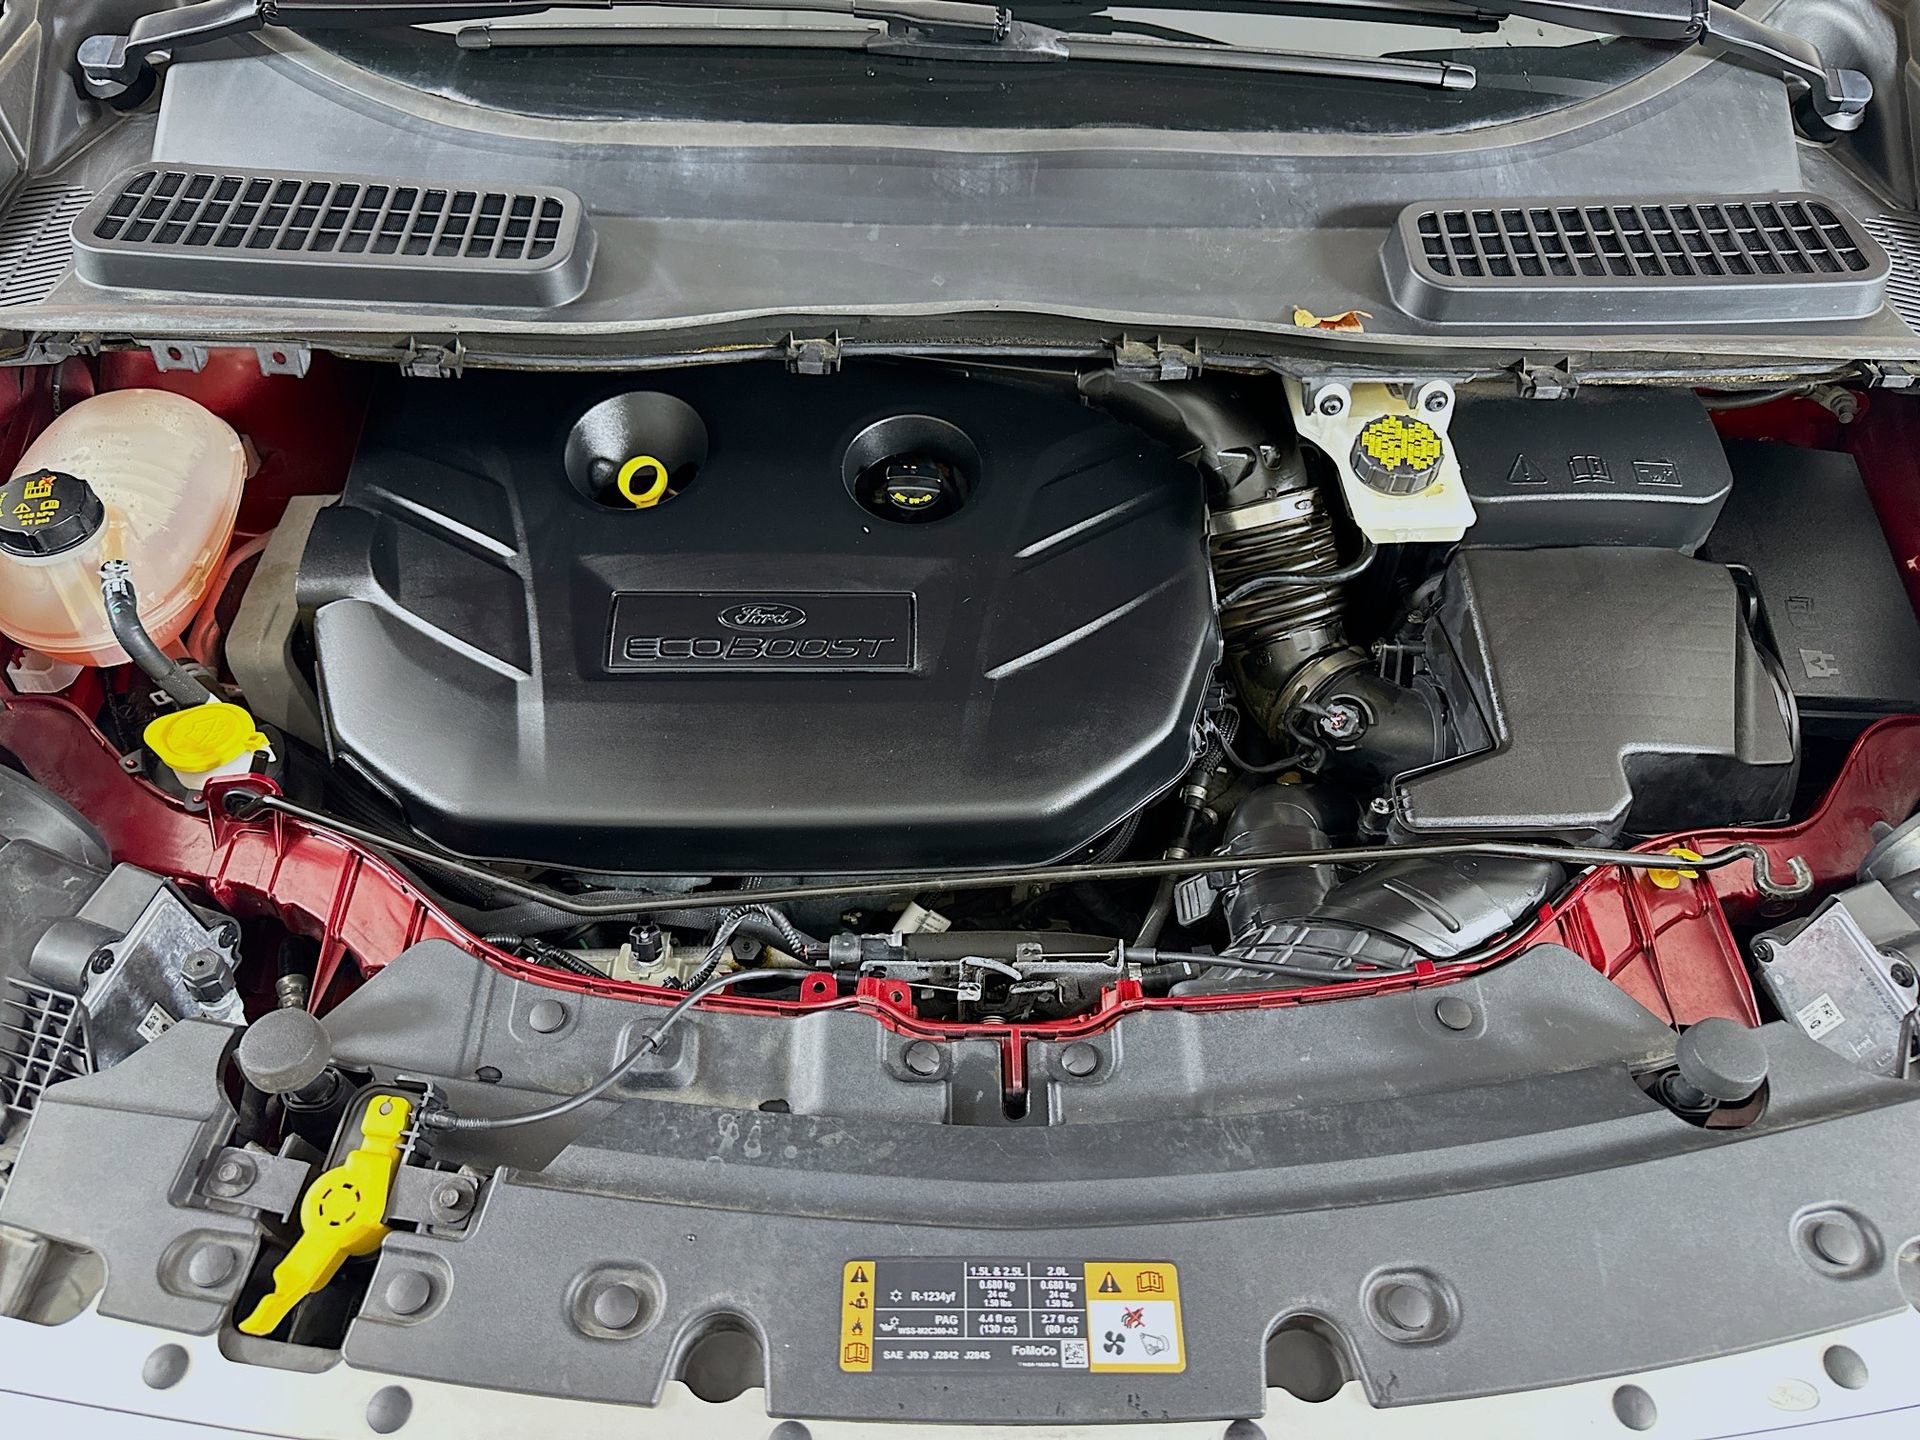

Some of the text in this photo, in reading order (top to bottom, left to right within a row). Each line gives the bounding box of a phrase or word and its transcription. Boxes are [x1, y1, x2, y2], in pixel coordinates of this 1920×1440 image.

[734, 605, 791, 624] Ford
[970, 1266, 1024, 1276] 1.5L & 2.5L
[1047, 1266, 1069, 1276] 2.0L
[1004, 1280, 1016, 1292] kg
[1065, 1280, 1077, 1292] kg
[911, 1291, 956, 1303] R-1234yf
[1000, 1299, 1012, 1307] lbs
[1062, 1300, 1074, 1308] lbs
[935, 1314, 959, 1325] PAG
[978, 1314, 1017, 1324] 4.4 fl oz
[1041, 1314, 1079, 1324] 2.7 fl oz
[1002, 1325, 1018, 1336] cc)
[1062, 1325, 1078, 1336] cc)
[883, 1350, 904, 1360] SAE
[907, 1351, 929, 1360] J639
[1011, 1345, 1058, 1356] FoMoCo
